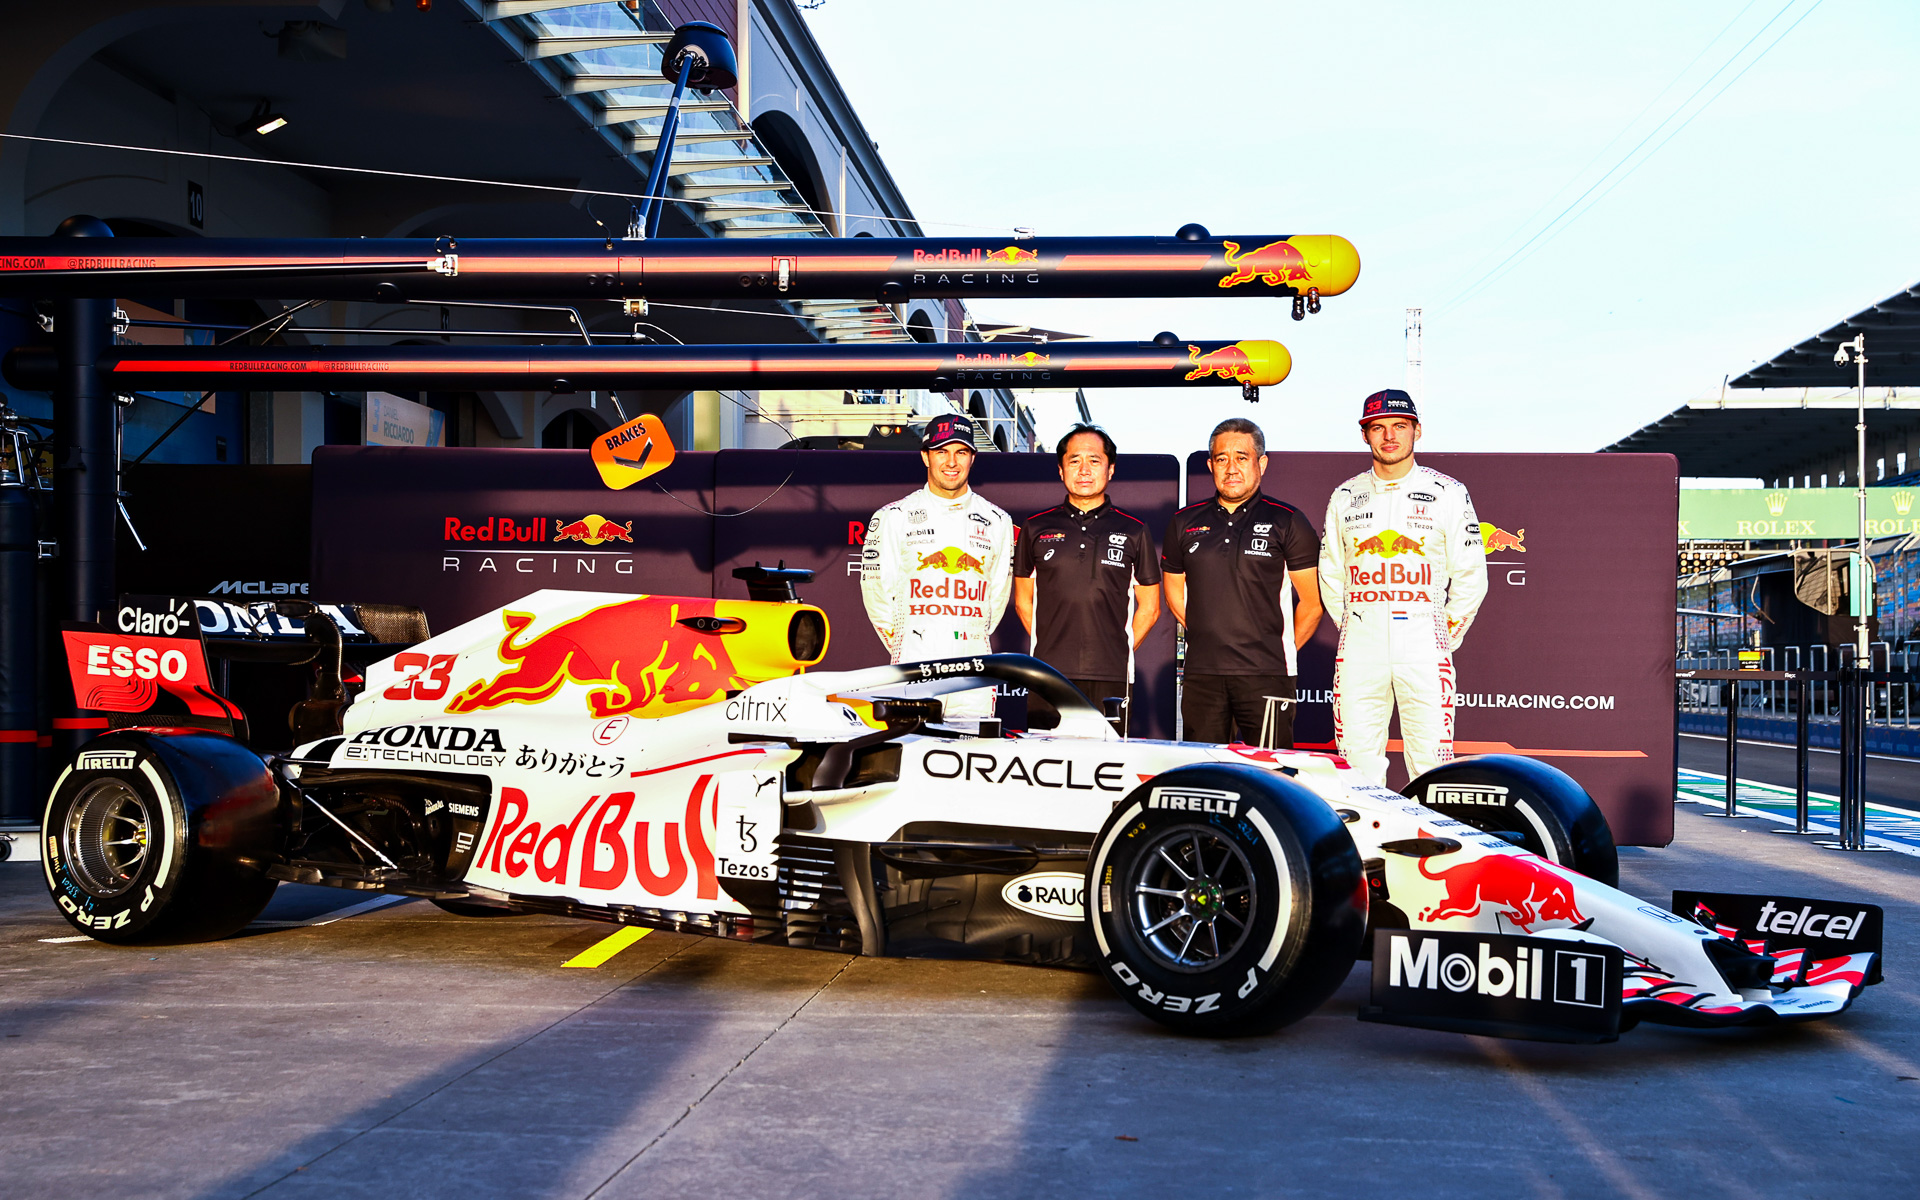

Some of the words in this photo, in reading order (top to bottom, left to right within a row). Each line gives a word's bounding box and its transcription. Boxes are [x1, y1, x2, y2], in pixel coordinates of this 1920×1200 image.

[190, 191, 203, 221] 10
[67, 258, 157, 269] @REDBULLRACING
[913, 249, 946, 264] Red
[948, 249, 982, 264] Bull
[913, 274, 1039, 284] RACING
[229, 361, 307, 372] REDBULLRACING.COM
[322, 361, 389, 372] @REDBULLRACING
[956, 353, 982, 365] Red
[983, 353, 1008, 365] Bull
[956, 372, 1051, 380] RACING
[1367, 400, 1382, 413] 33
[605, 422, 647, 451] BRAKES
[937, 422, 950, 432] 11
[1353, 493, 1368, 501] TAG
[909, 509, 926, 517] TAG
[1344, 513, 1365, 523] Mobil
[444, 516, 494, 541] Red
[498, 517, 547, 542] Bull
[906, 529, 927, 537] Mobil
[1736, 520, 1816, 535] ROLEX
[442, 556, 633, 574] RACING
[1349, 562, 1386, 586] Red
[1390, 563, 1431, 586] Bull
[910, 577, 949, 599] Red
[953, 579, 987, 601] Bull
[1349, 590, 1432, 603] HONDA
[909, 604, 983, 618] HONDA
[87, 644, 188, 682] ESSO
[933, 661, 971, 674] Tezos
[725, 696, 787, 722] citrix
[1454, 693, 1615, 710] BULLRACING.COM
[351, 725, 507, 752] HONDA
[76, 750, 137, 770] PIRELLI
[515, 744, 626, 779] ありがとう
[923, 749, 1125, 791] ORACLE
[1148, 787, 1241, 818] PIRELLI
[1426, 783, 1509, 807] PIRELLI
[448, 802, 479, 817] SIEMENS
[476, 786, 600, 885] Red
[579, 773, 718, 900] Bul
[718, 857, 769, 878] Tezos
[140, 885, 154, 912] P
[58, 894, 131, 930] ZERO
[1756, 901, 1867, 940] telcel
[1389, 935, 1543, 1000] Mobil
[1571, 957, 1587, 1001] 1
[1111, 961, 1221, 1014] ZERO
[1238, 967, 1258, 999] P
